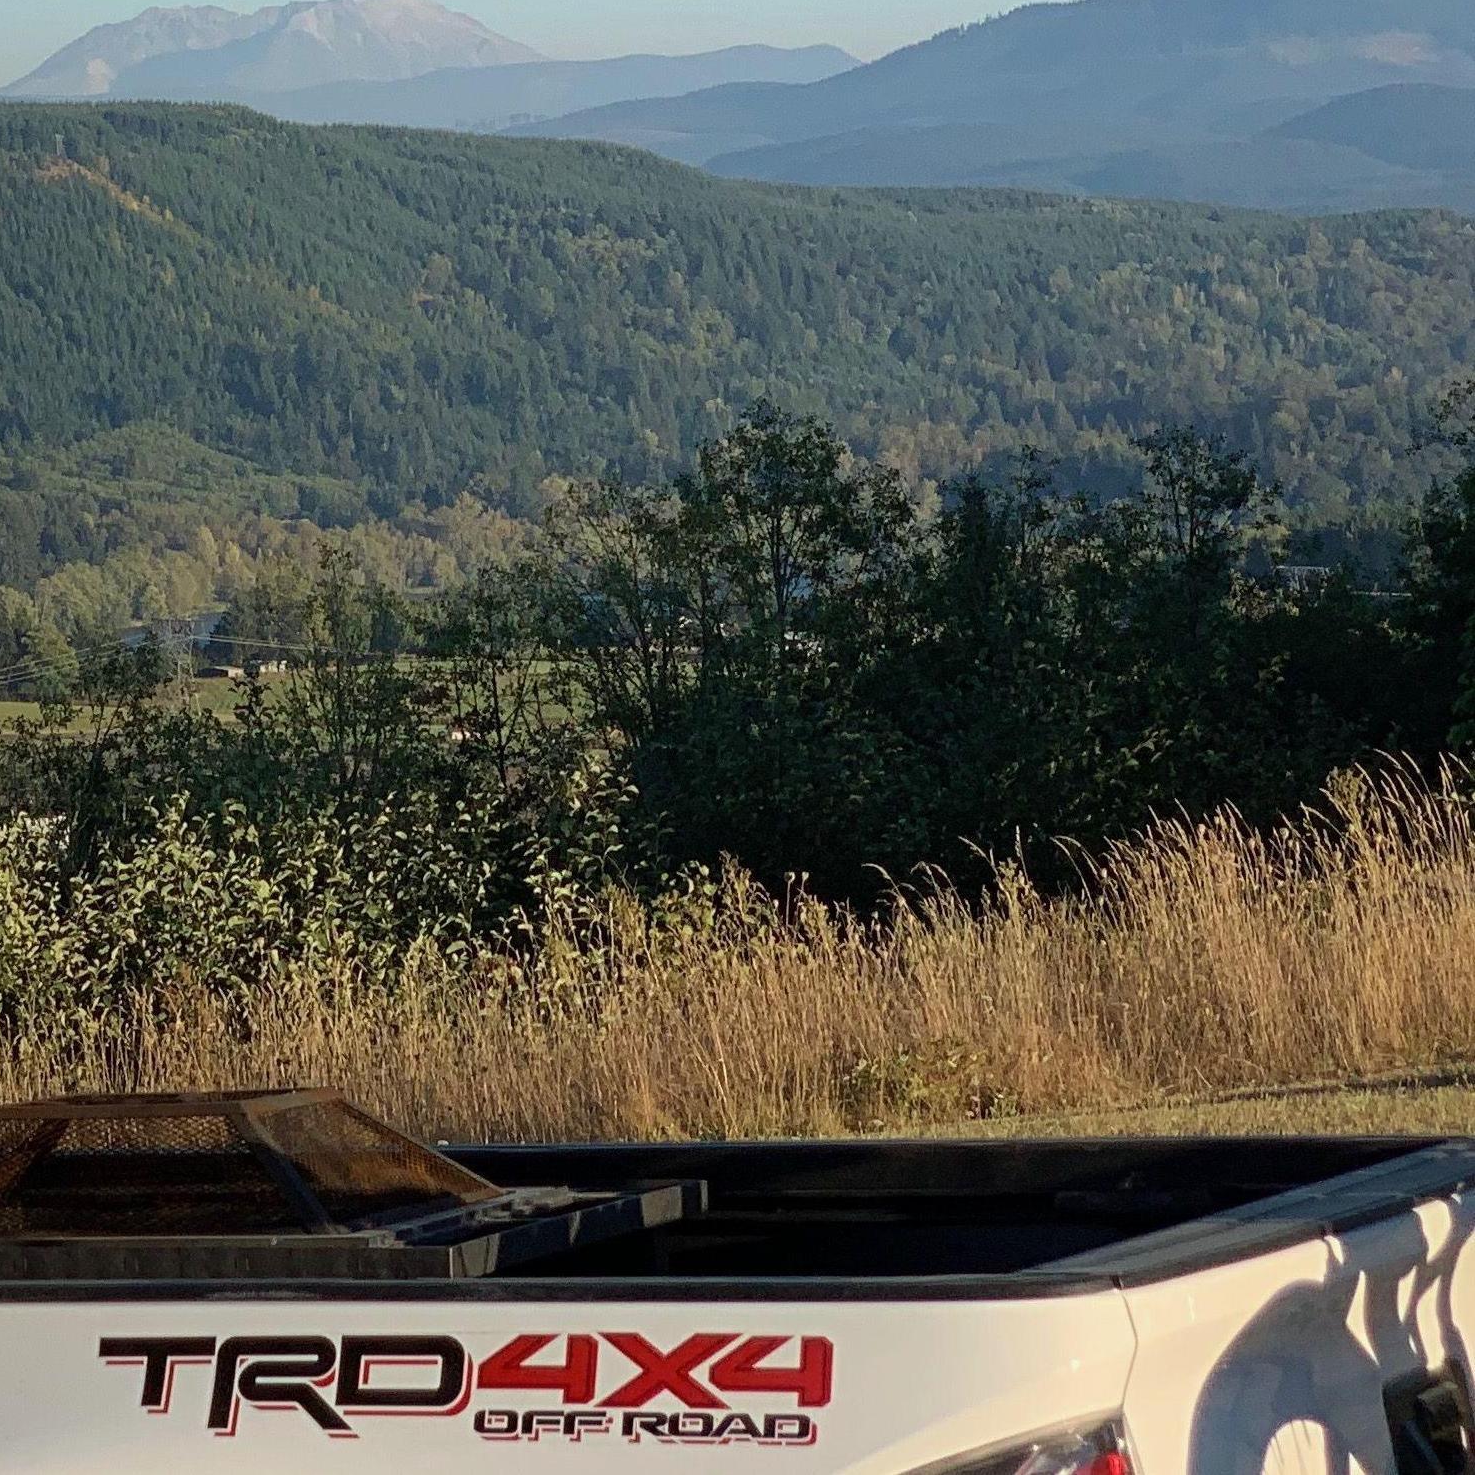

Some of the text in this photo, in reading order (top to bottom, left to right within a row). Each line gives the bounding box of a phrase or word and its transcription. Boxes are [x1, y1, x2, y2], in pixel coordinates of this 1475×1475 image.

[98, 1334, 472, 1438] TRD
[473, 1409, 818, 1446] OFF ROAD
